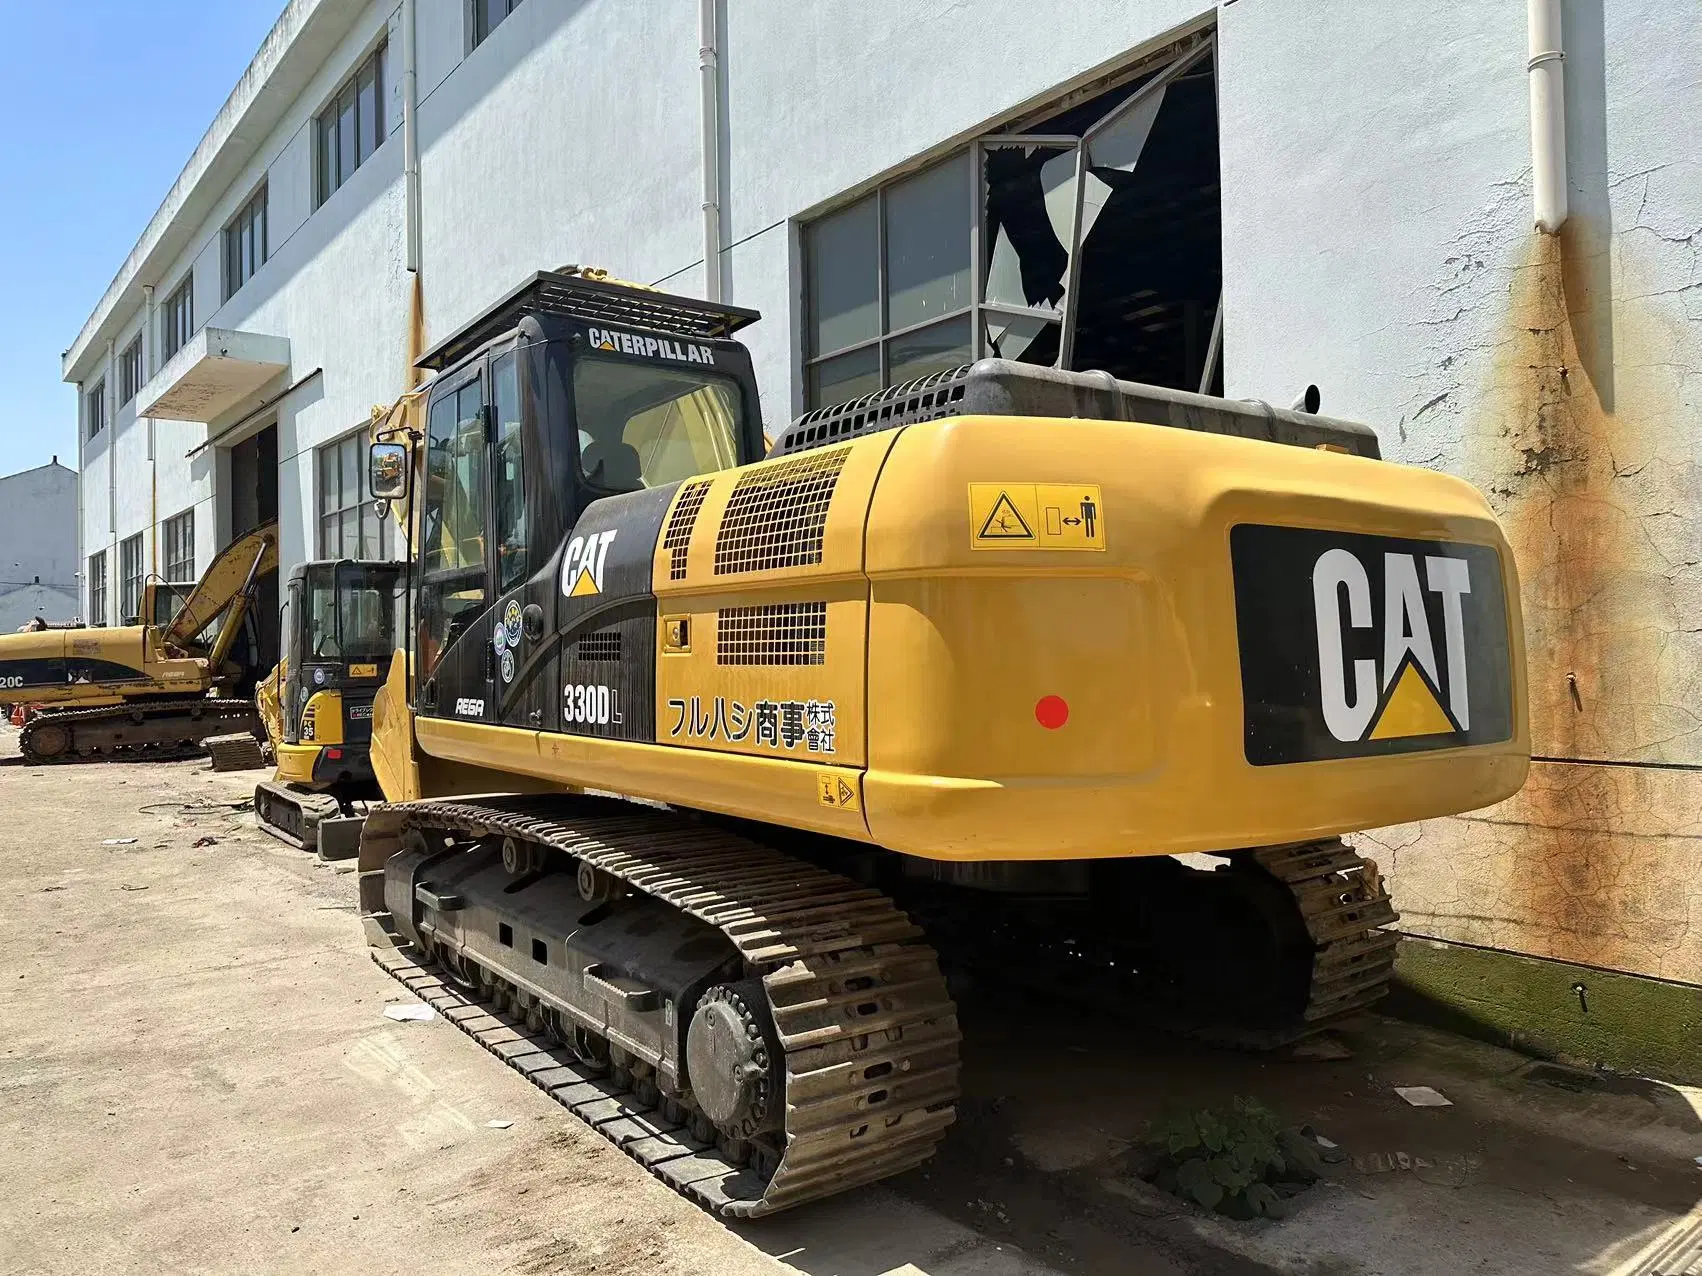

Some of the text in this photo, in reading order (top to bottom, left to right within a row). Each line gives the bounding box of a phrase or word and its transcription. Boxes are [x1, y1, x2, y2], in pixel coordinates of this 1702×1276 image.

[588, 327, 715, 365] CATERPILLAR
[562, 529, 617, 598] CAT
[1312, 548, 1471, 742] CAT
[303, 727, 314, 736] 35
